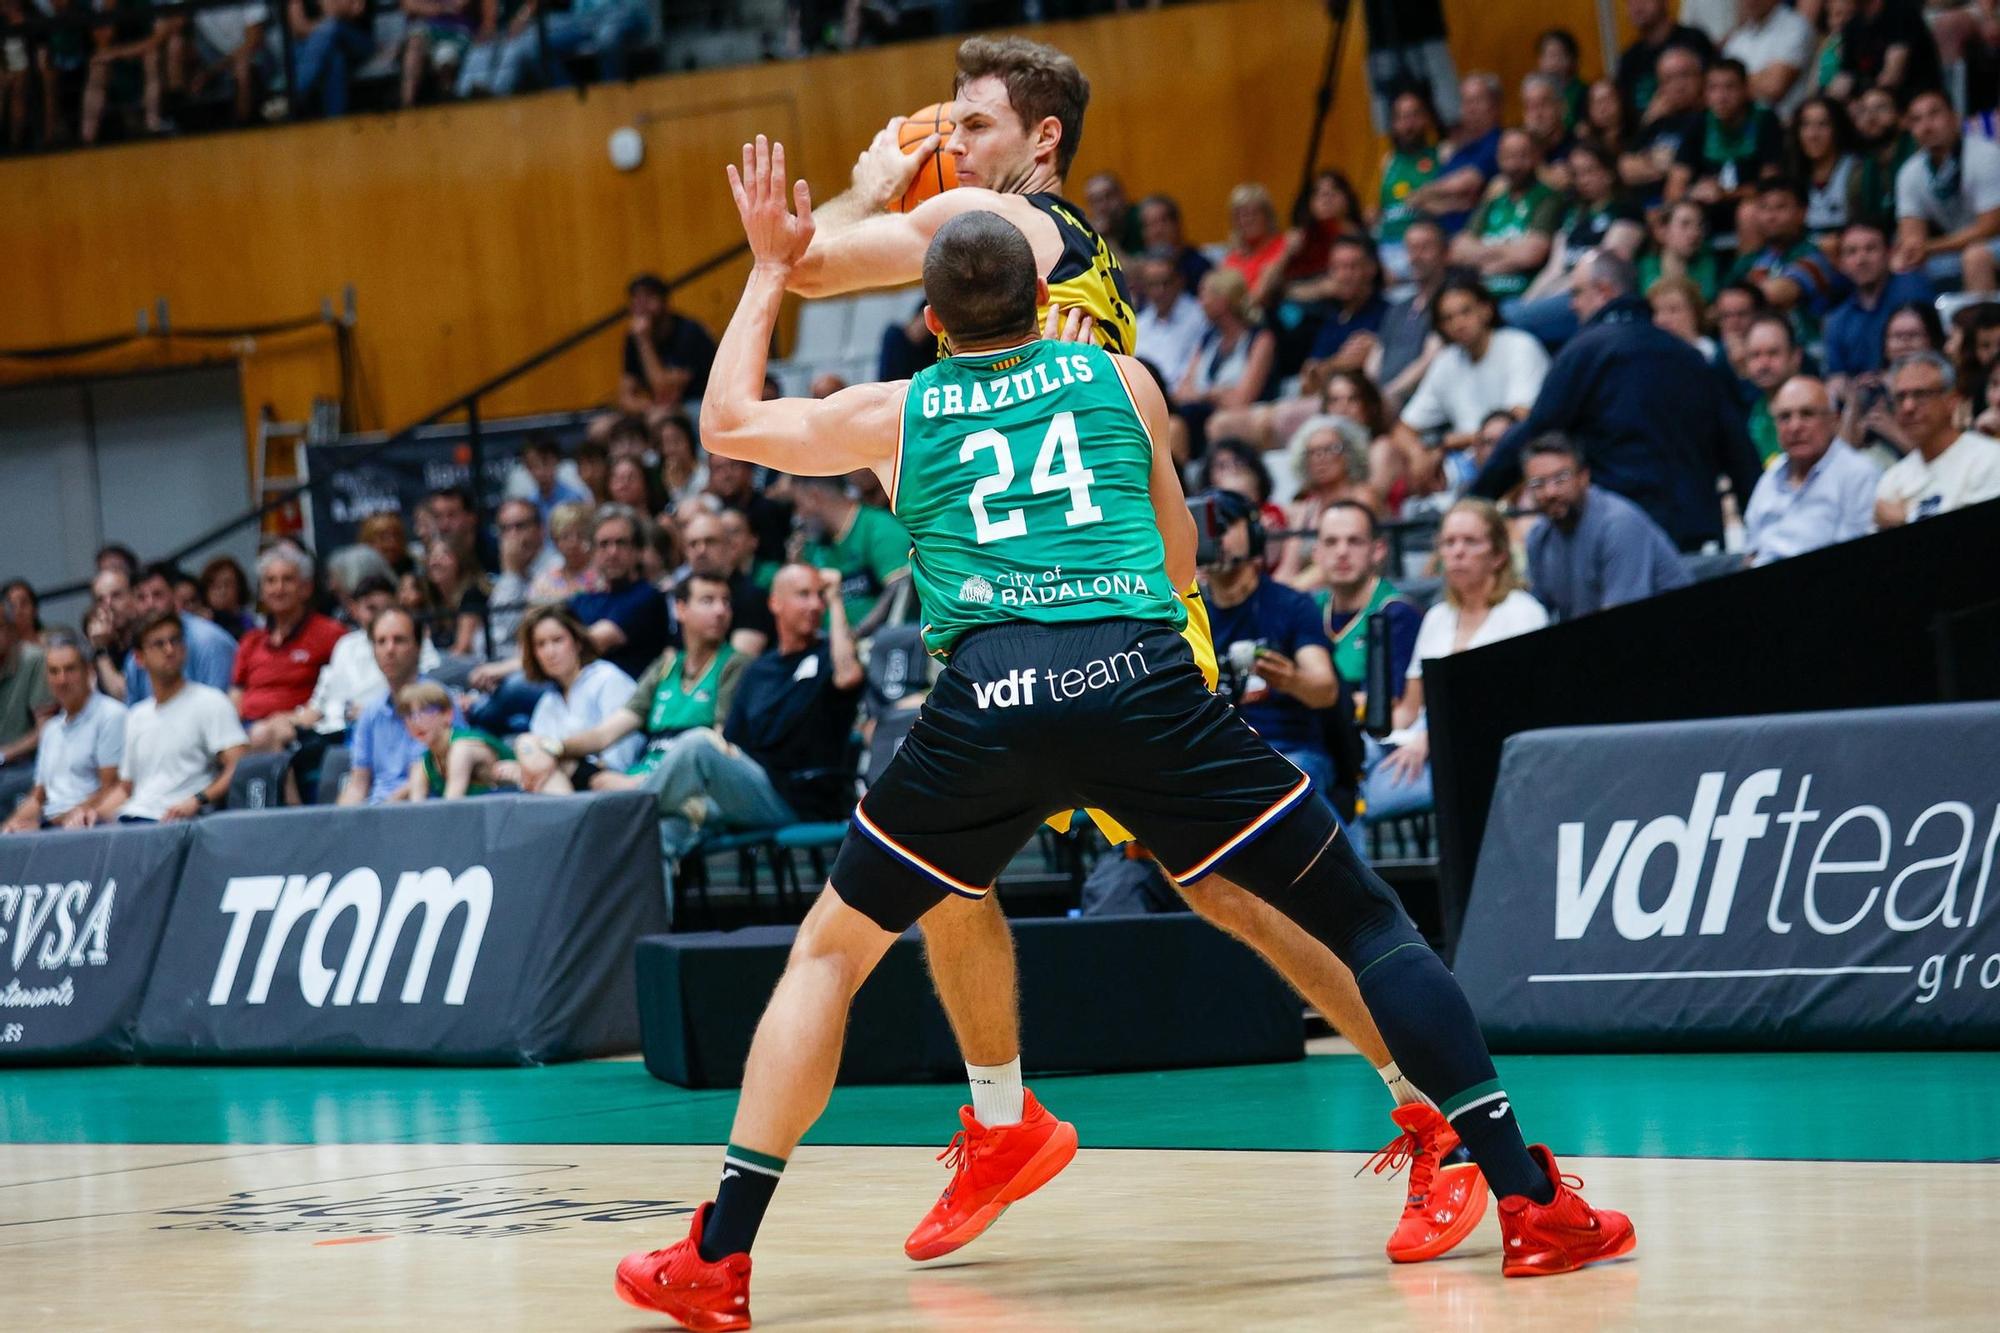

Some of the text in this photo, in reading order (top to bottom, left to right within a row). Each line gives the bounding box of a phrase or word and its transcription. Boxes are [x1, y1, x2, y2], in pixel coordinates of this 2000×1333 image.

[923, 355, 1093, 419] GRAZULIS
[959, 411, 1103, 545] 24
[996, 565, 1062, 588] City of
[1001, 575, 1149, 606] BADALONA
[972, 643, 1150, 709] vdf team
[1555, 768, 1782, 942] vdf
